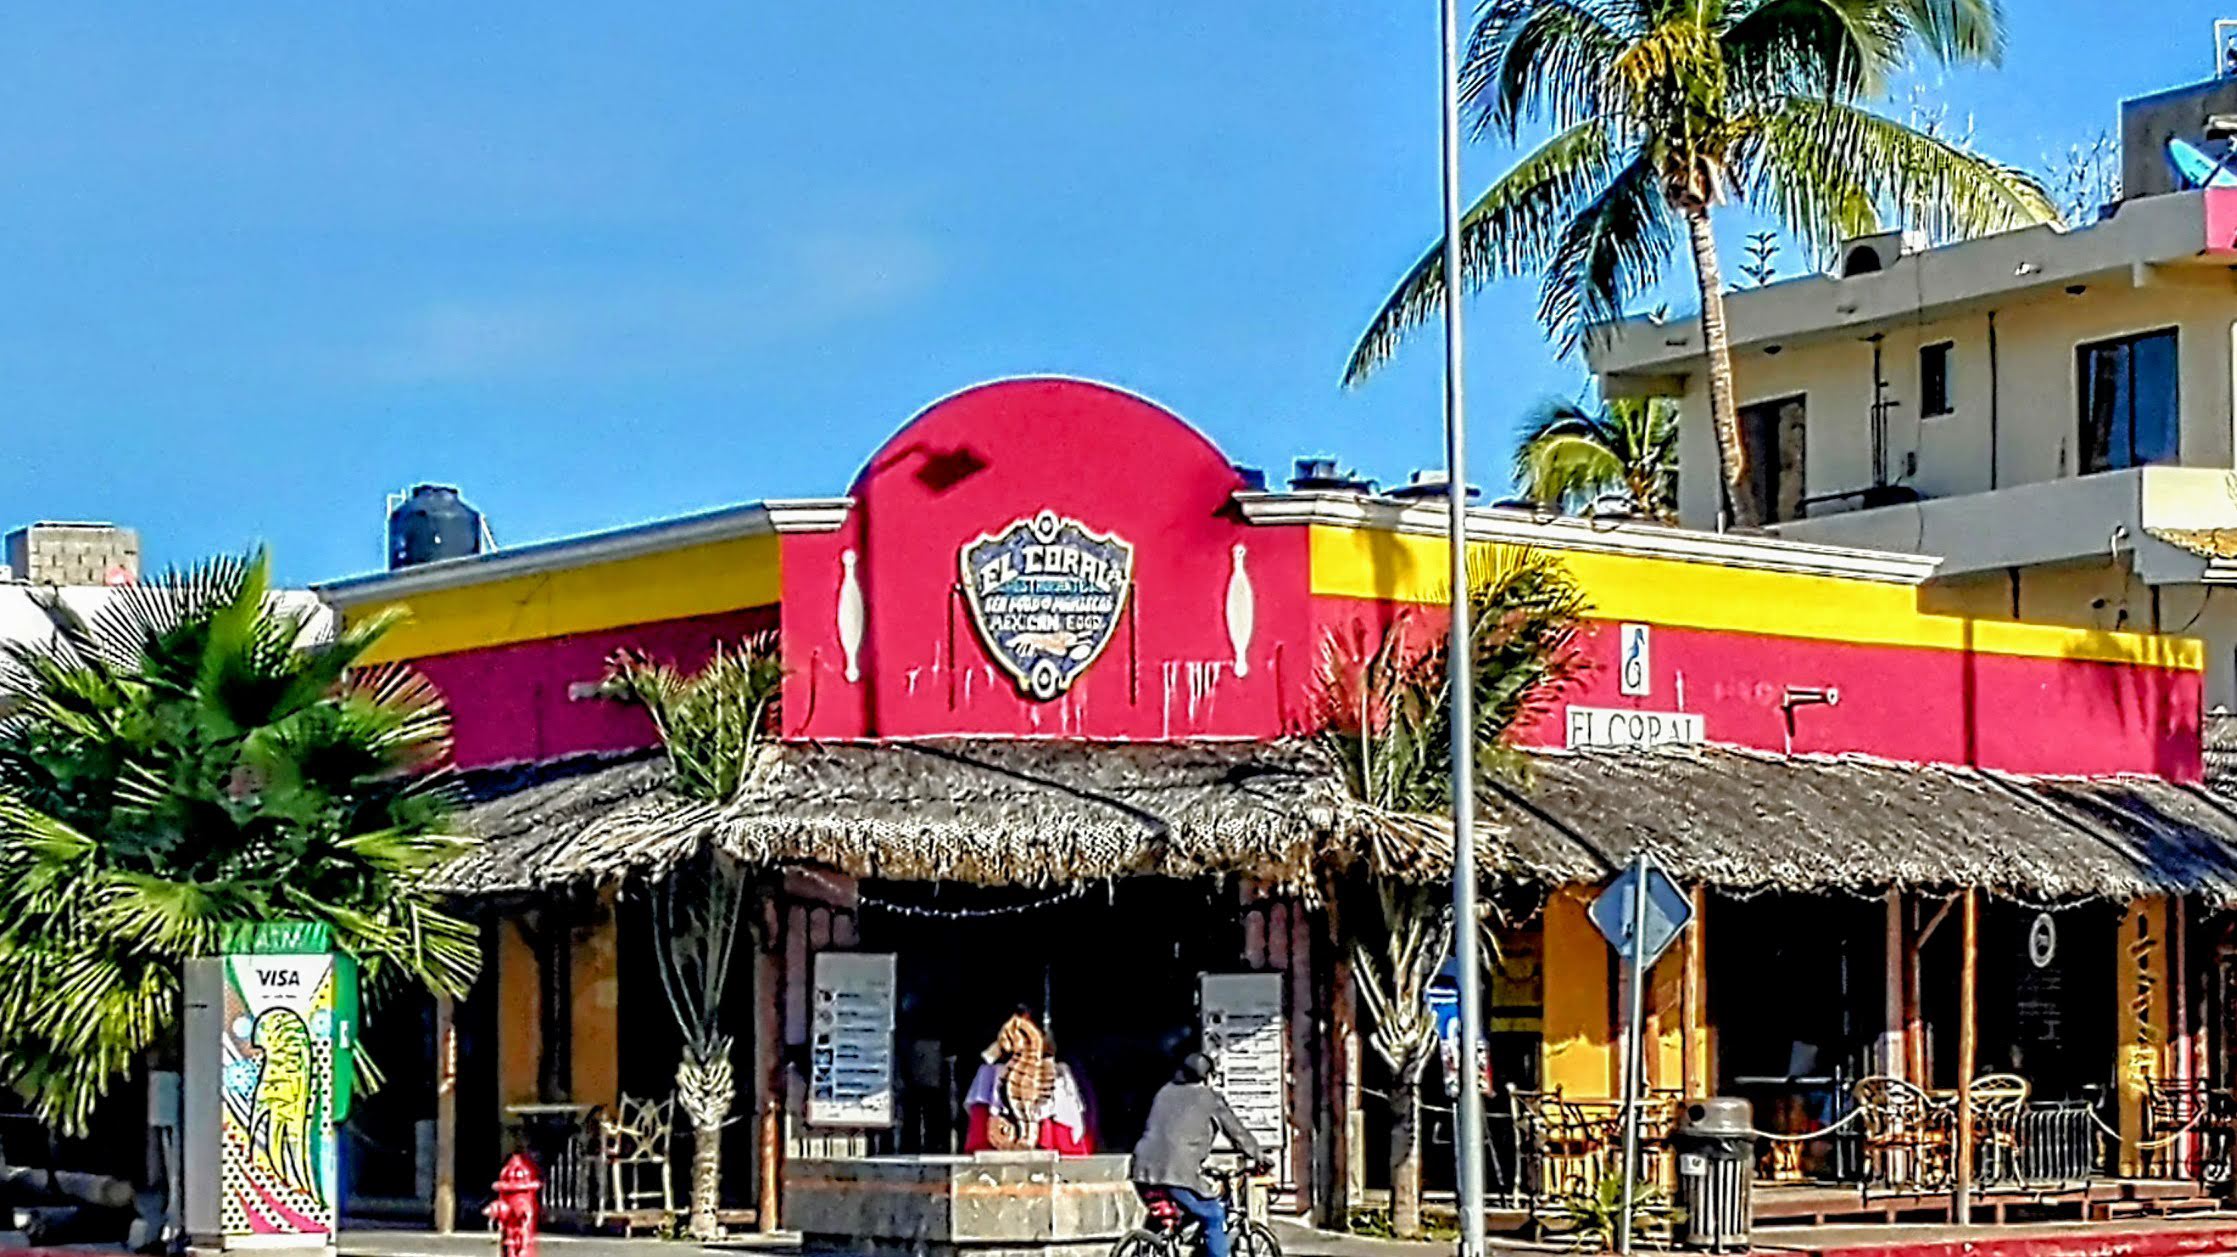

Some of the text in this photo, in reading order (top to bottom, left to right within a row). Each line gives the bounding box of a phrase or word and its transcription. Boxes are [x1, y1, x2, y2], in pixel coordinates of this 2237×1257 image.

[980, 544, 1113, 597] EL CORAL
[989, 614, 1061, 632] MEXICAN
[256, 969, 300, 986] VISA
